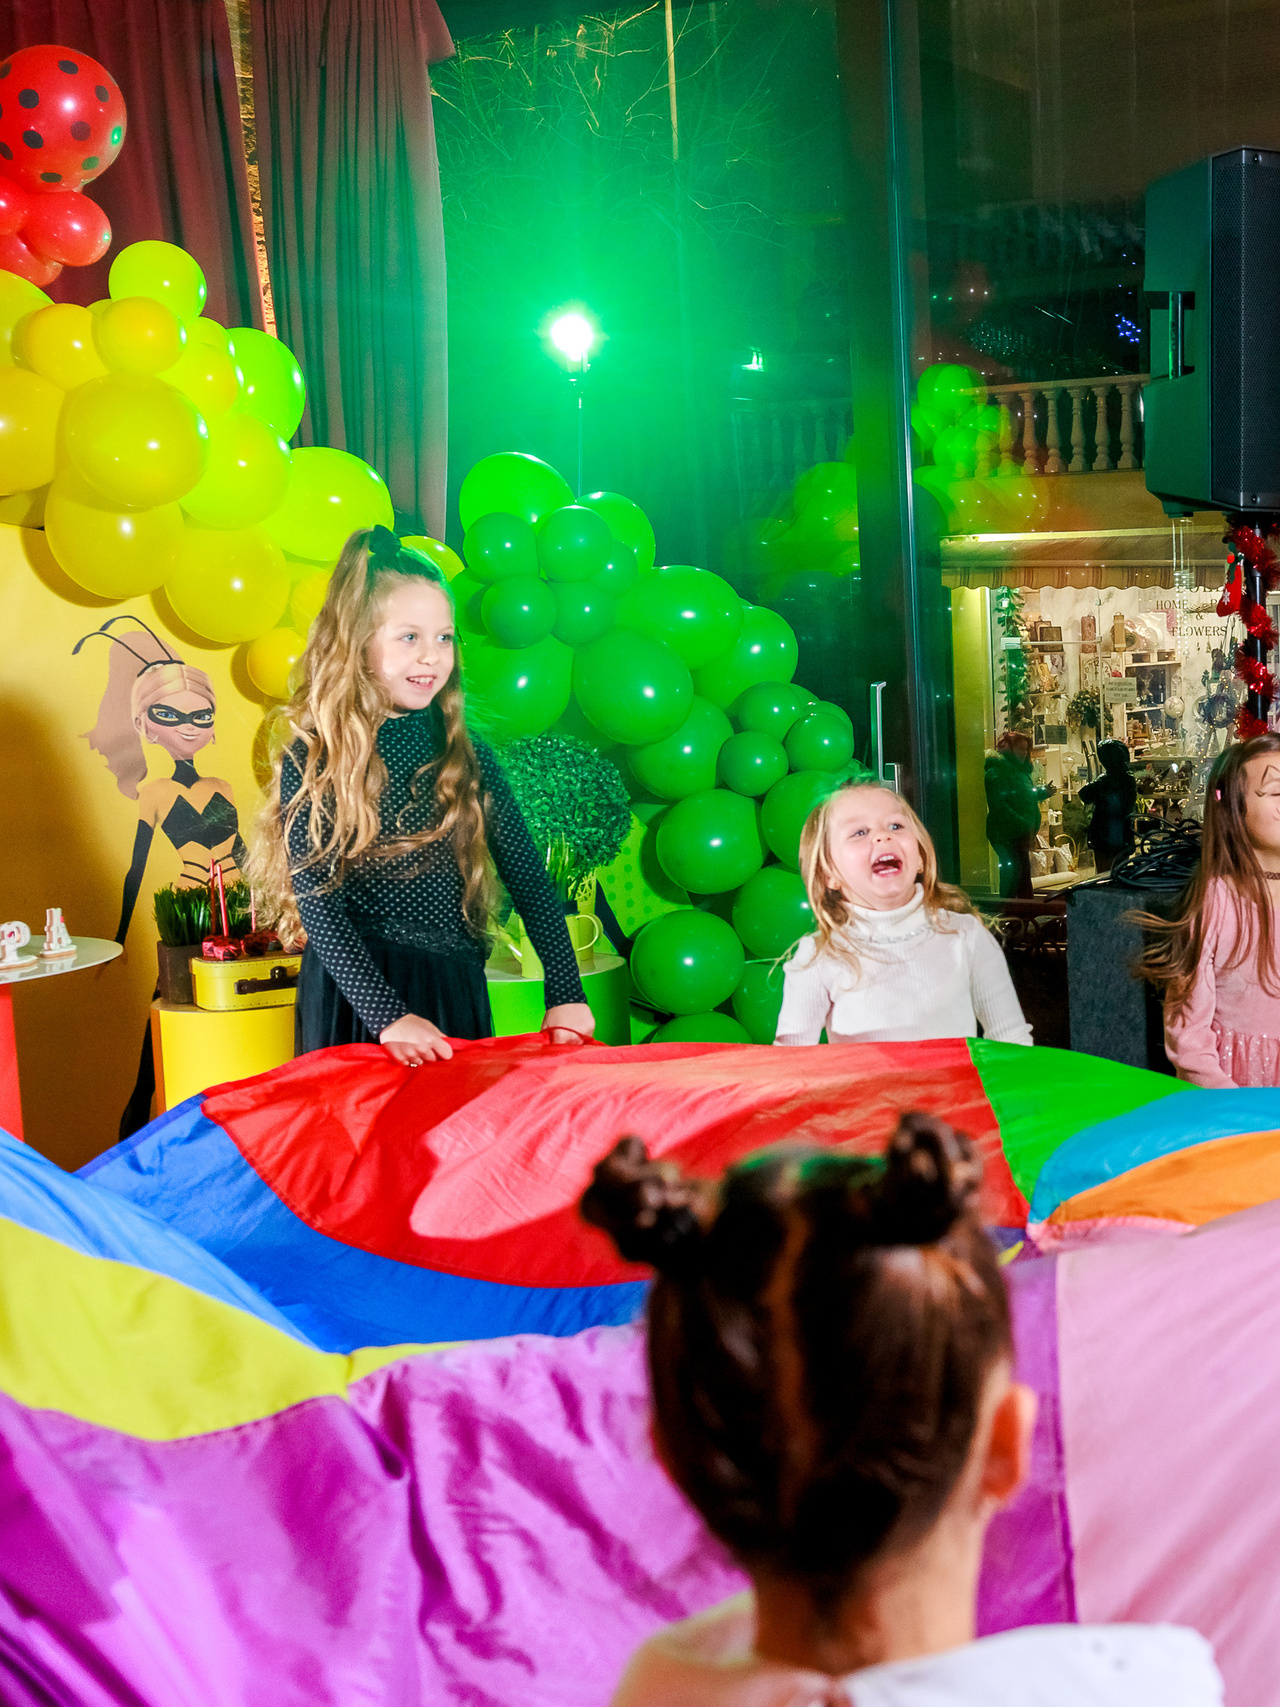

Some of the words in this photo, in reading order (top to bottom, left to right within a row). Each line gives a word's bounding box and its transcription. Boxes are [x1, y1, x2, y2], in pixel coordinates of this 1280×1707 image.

[1156, 599, 1189, 610] HOME
[1195, 612, 1204, 621] &
[1171, 625, 1227, 637] FLOWERS
